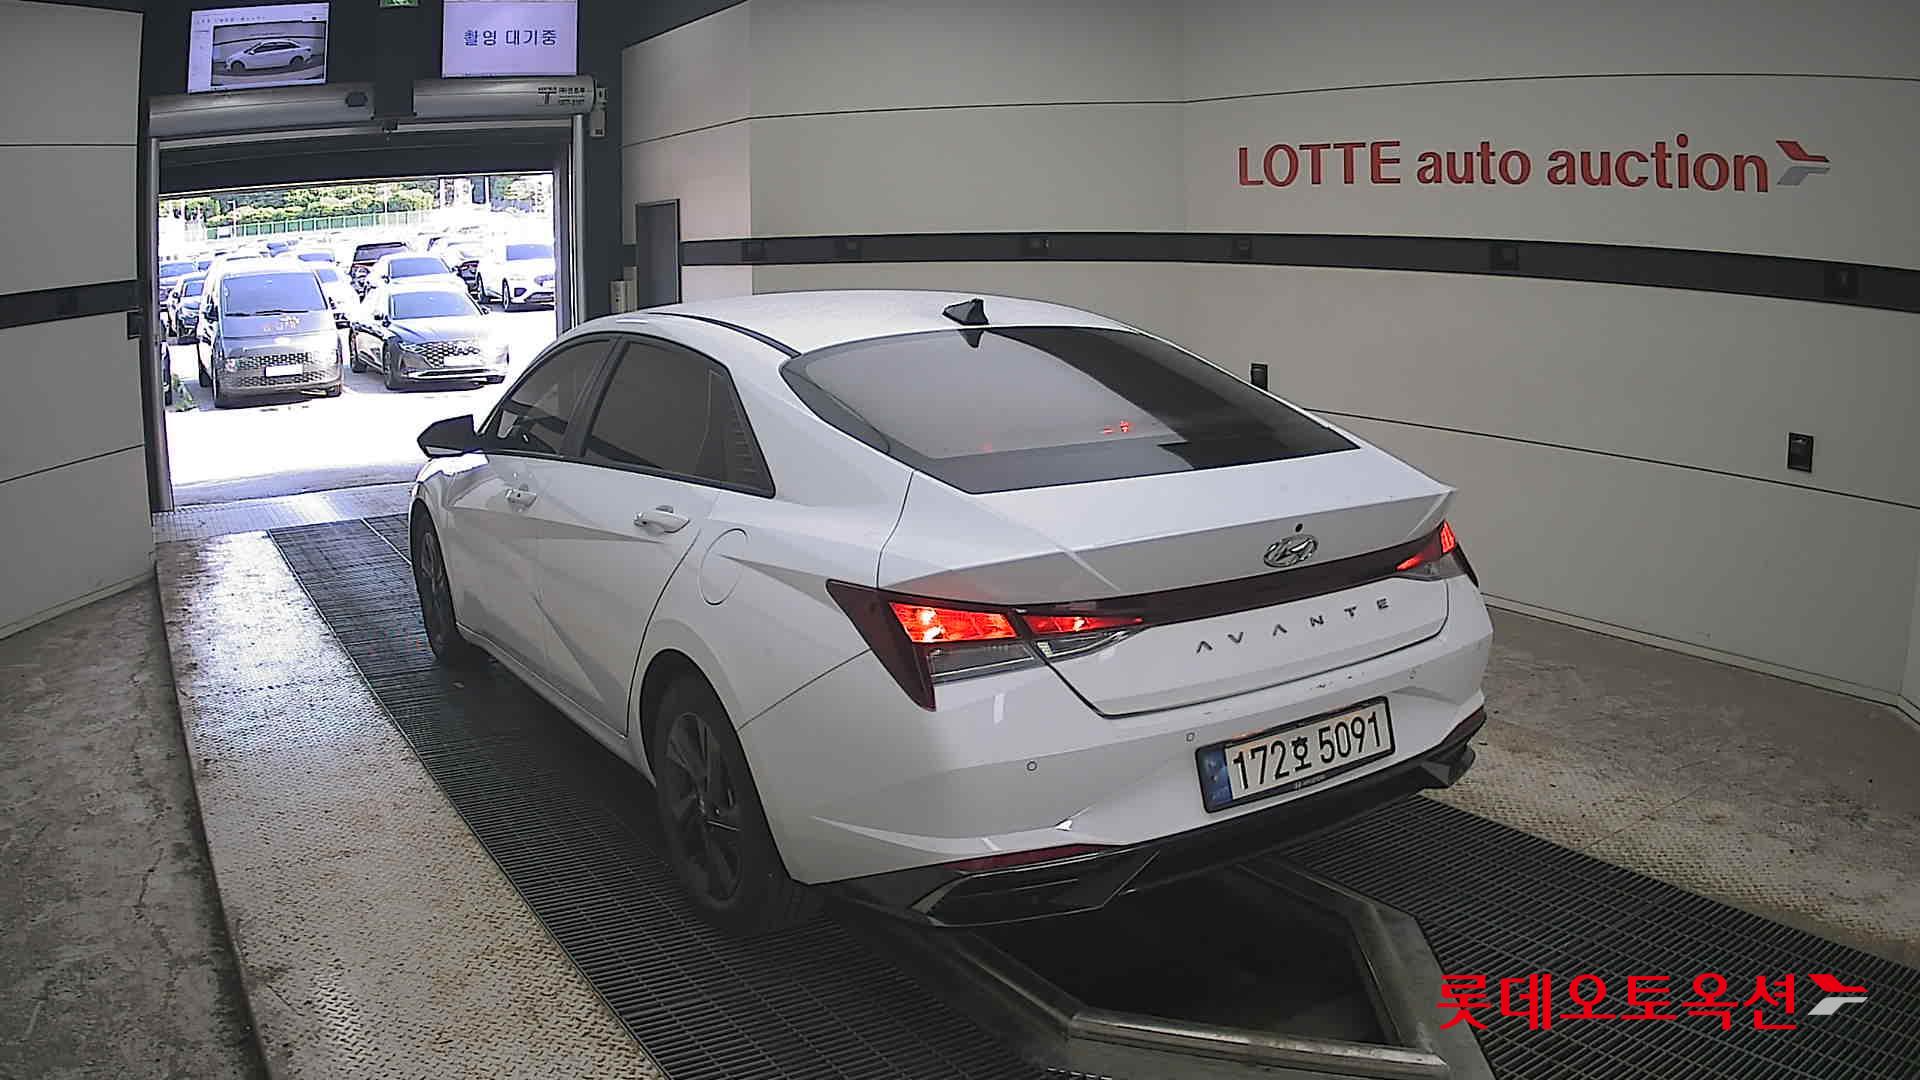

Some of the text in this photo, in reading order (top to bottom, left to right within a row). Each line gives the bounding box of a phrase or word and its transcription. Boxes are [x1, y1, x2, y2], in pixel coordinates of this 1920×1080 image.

[505, 29, 557, 46] 대기중
[1238, 133, 1769, 193] LOTTE auto auction
[1196, 598, 1389, 653] AVANTE
[1233, 711, 1381, 790] 172호 5091
